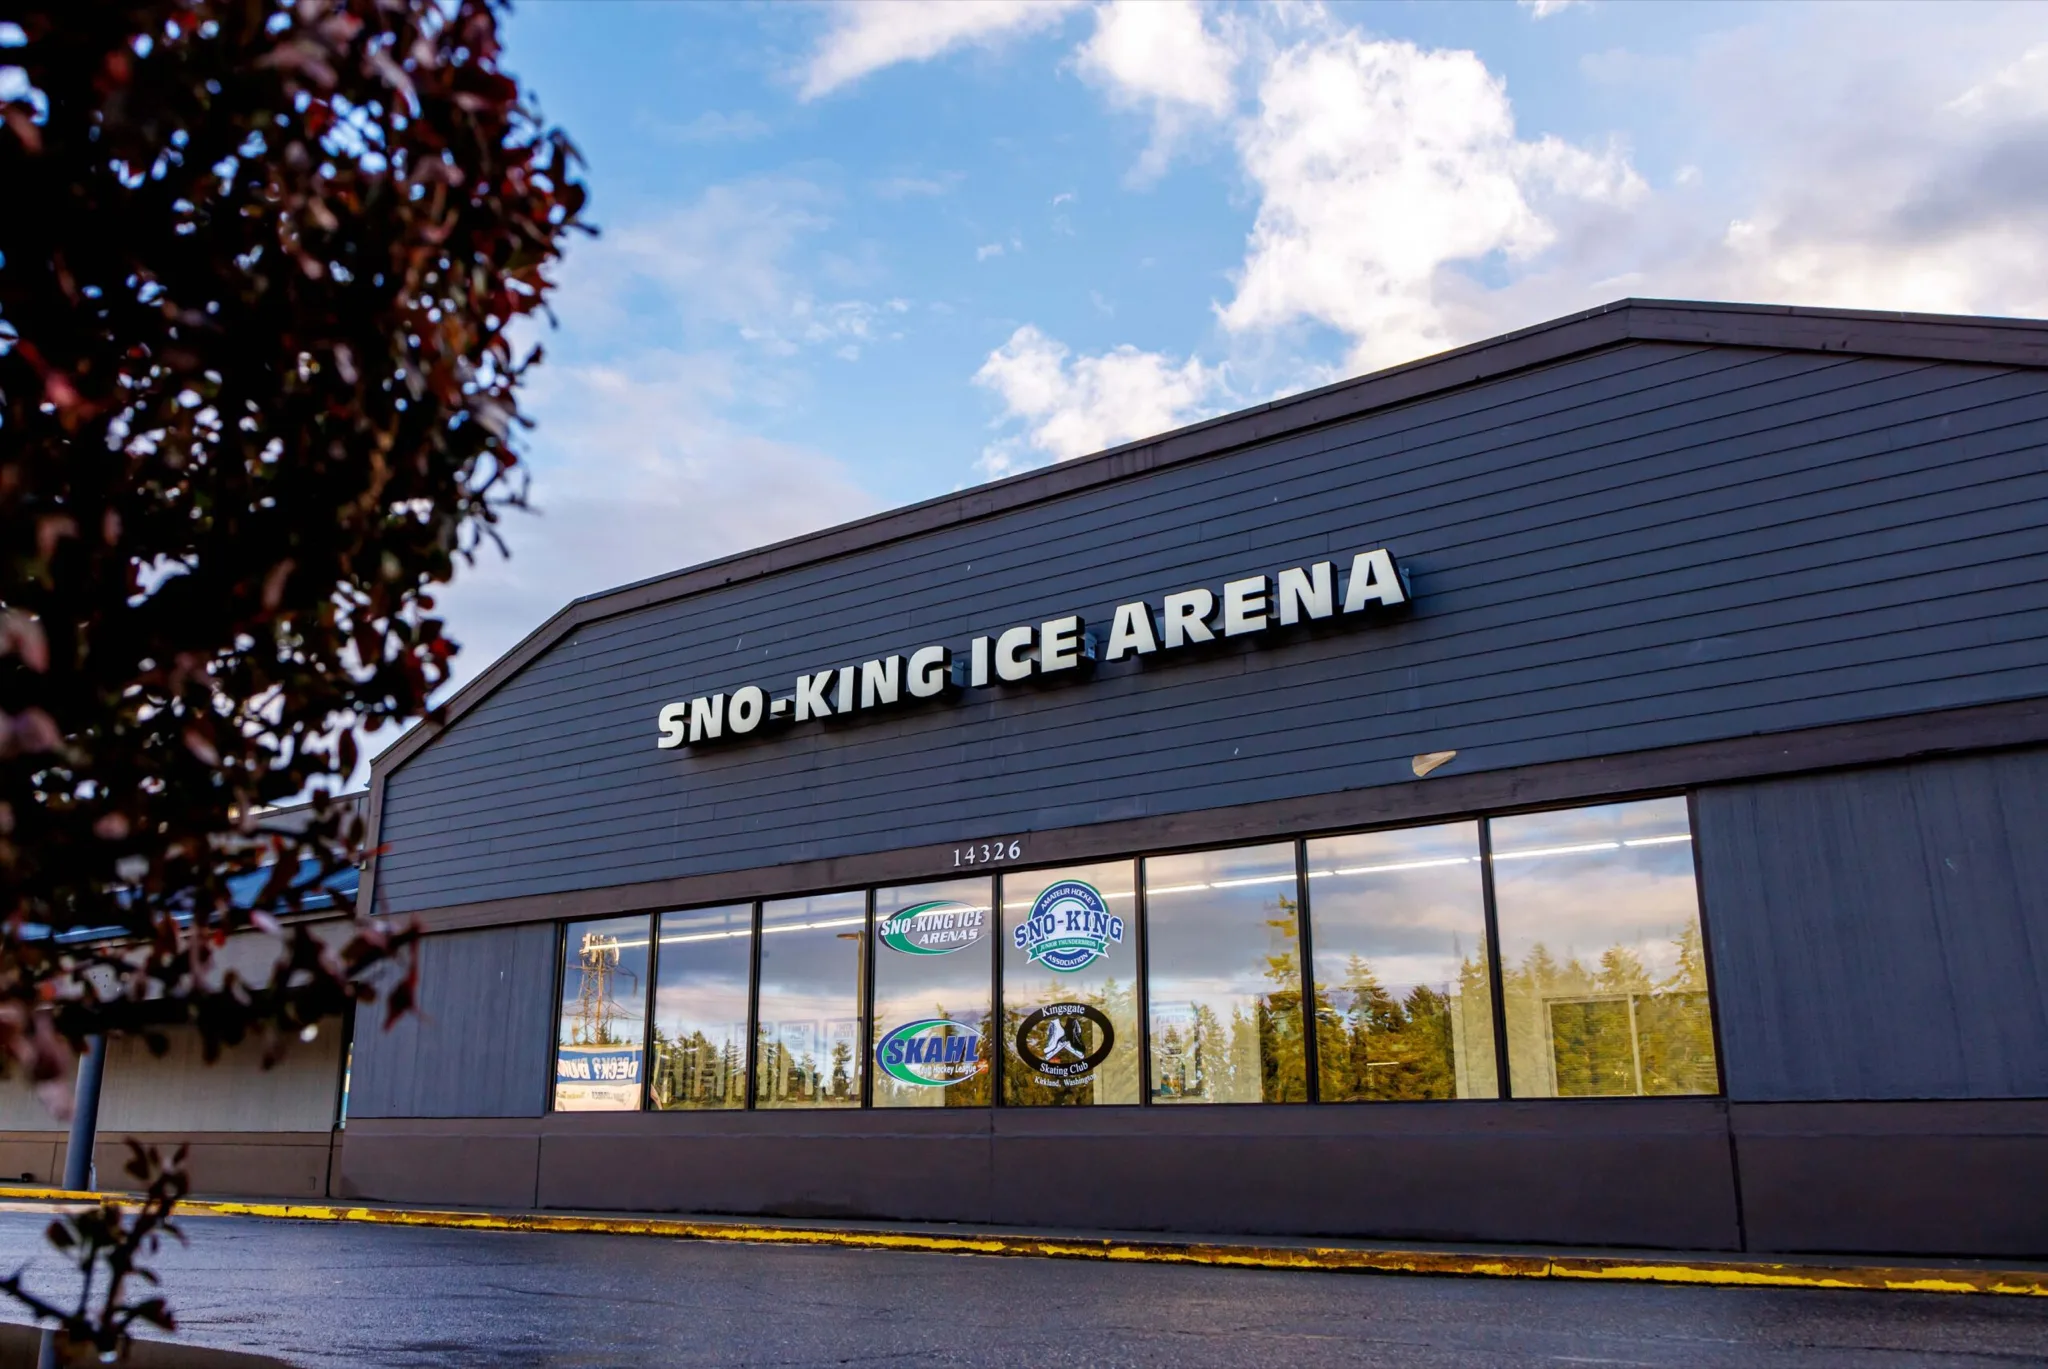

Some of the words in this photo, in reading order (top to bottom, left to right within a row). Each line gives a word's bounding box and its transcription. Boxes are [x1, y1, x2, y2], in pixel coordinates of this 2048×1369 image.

[657, 645, 944, 749] SNO-KING
[971, 614, 1078, 687] ICE
[1105, 547, 1406, 661] ARENA
[953, 840, 1021, 867] 14326
[1041, 888, 1070, 910] AMATEUR
[1071, 888, 1096, 907] HOCKEY
[880, 913, 955, 936] SNO-KING
[957, 910, 984, 928] ICE
[1014, 910, 1123, 947] SNO-KING
[918, 928, 979, 945] ARENAS
[1047, 953, 1089, 967] ASSOCIATION
[1042, 1004, 1085, 1017] Kingsgate
[886, 1035, 979, 1065] SKAHL
[933, 1065, 954, 1075] Hockey
[955, 1064, 977, 1075] League
[1040, 1062, 1068, 1077] Skating
[1069, 1061, 1089, 1074] Club
[1034, 1075, 1061, 1087] Kirkland,
[1063, 1073, 1098, 1087] Washington
